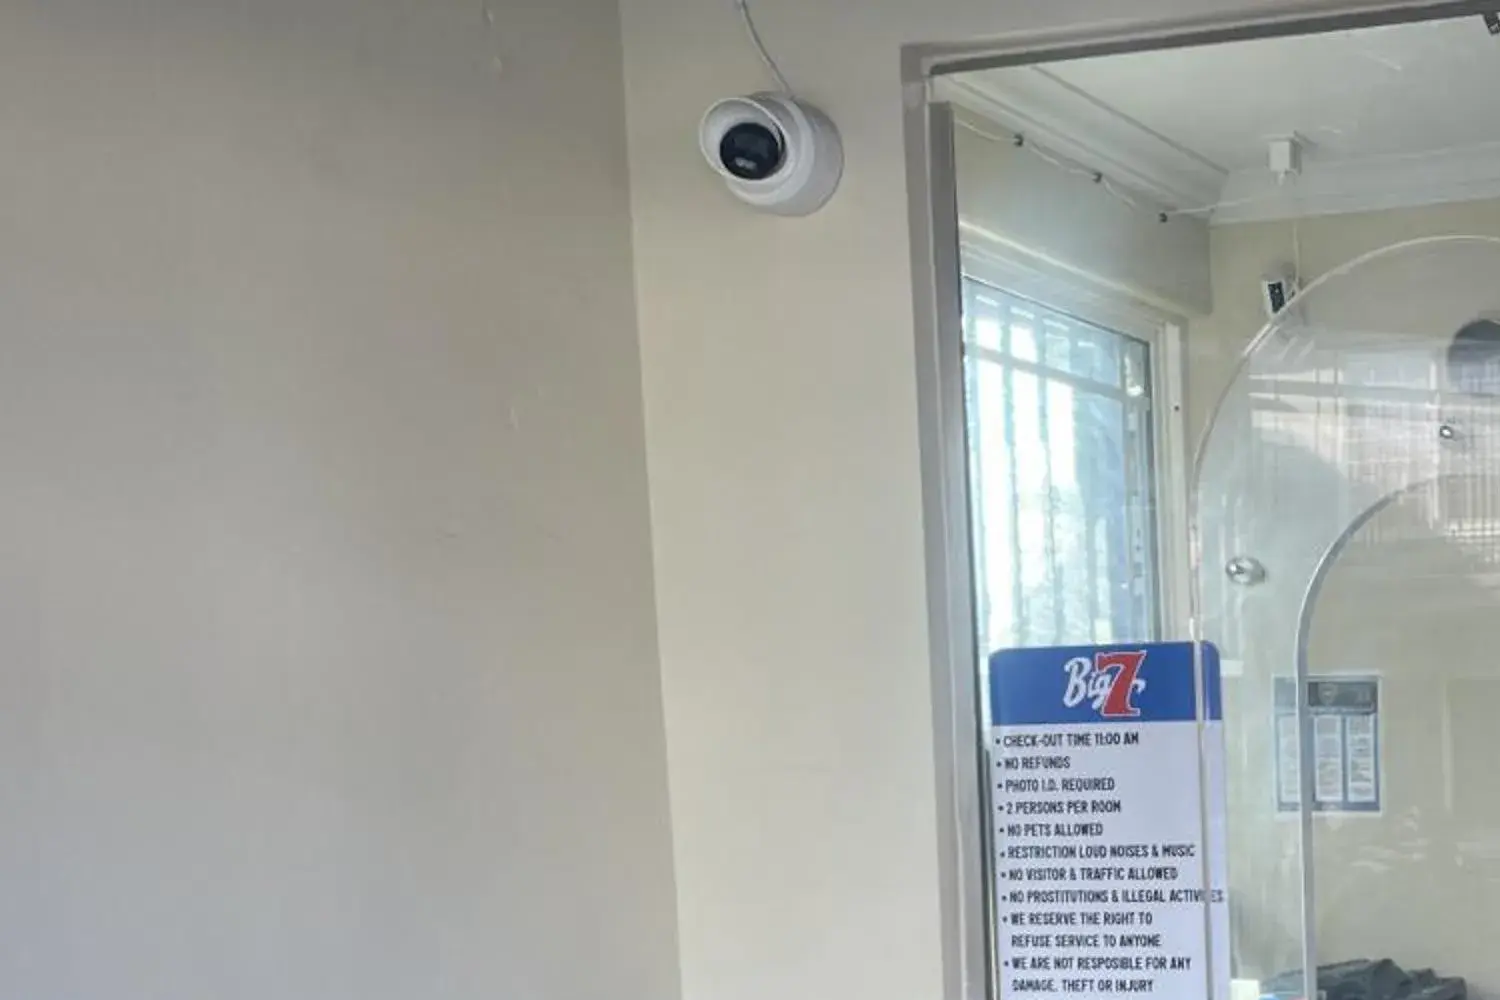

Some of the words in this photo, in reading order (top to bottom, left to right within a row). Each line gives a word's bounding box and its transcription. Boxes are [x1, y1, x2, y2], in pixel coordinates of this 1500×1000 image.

[1062, 656, 1113, 710] Big
[1094, 649, 1147, 717] 7
[1003, 733, 1062, 747] CHECK-OUT
[1066, 732, 1092, 746] TIME
[1094, 731, 1121, 746] 11:00
[1123, 731, 1139, 745] AM
[1004, 756, 1018, 770] NO
[1021, 755, 1071, 770] REFUNDS
[1005, 778, 1039, 793] PHOTO
[1041, 777, 1058, 792] I.D.
[1061, 776, 1115, 792] REQUIRED
[1006, 801, 1013, 814] 2
[1016, 800, 1064, 815] PERSONS
[1067, 800, 1088, 814] PER
[1091, 799, 1121, 813] ROOM
[1007, 823, 1021, 836] NO
[1024, 823, 1051, 837] PETS
[1054, 822, 1103, 837] ALLOWED
[1007, 845, 1077, 859] RESTRICTION
[1079, 844, 1107, 859] LOUD
[1109, 844, 1149, 858] NOISES
[1151, 844, 1159, 858] &
[1161, 843, 1196, 858] MUSIC
[1008, 867, 1023, 881] NO
[1026, 867, 1067, 881] VISITOR
[1069, 867, 1077, 881] &
[1080, 867, 1125, 881] TRAFFIC
[1127, 866, 1179, 881] ALLOWED
[1009, 889, 1024, 903] NO
[1026, 889, 1108, 904] PROSTITUTIONS
[1111, 889, 1119, 903] &
[1121, 888, 1166, 903] ILLEGAL
[1011, 911, 1026, 925] WE
[1028, 911, 1077, 926] RESERVE
[1080, 911, 1101, 925] THE
[1103, 911, 1135, 926] RIGHT
[1138, 911, 1153, 925] TO
[1011, 933, 1052, 948] REFUSE
[1054, 933, 1100, 948] SERVICE
[1103, 933, 1117, 948] TO
[1119, 933, 1162, 948] ANYONE
[1012, 956, 1028, 970] WE
[1030, 956, 1051, 970] ARE
[1053, 956, 1075, 970] NOT
[1077, 956, 1143, 970] RESPOSIBLE
[1145, 956, 1168, 970] FOR
[1169, 956, 1191, 970] ANY
[1062, 978, 1095, 992] THEFT
[1097, 978, 1113, 992] OR
[1115, 978, 1154, 992] INJURY
